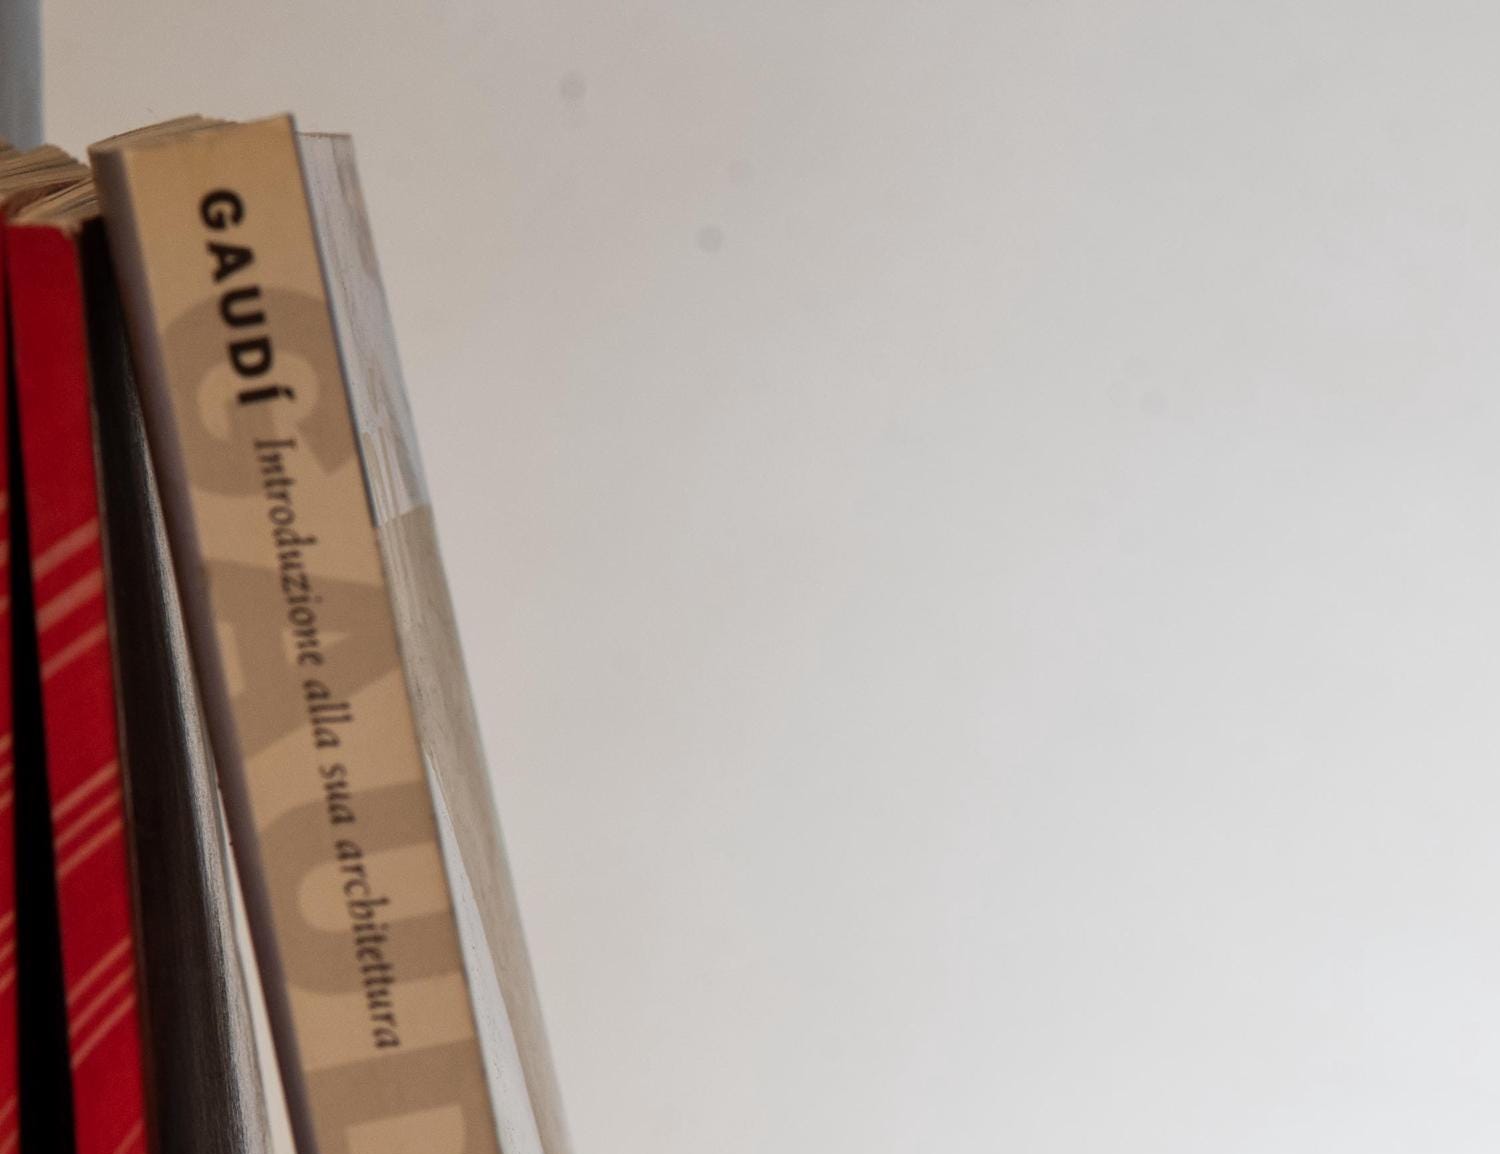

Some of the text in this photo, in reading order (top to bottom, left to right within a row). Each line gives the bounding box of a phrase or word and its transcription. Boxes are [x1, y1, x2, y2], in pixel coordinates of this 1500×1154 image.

[199, 188, 399, 1050] GAUDÍ Introduzione alla sua architettura
